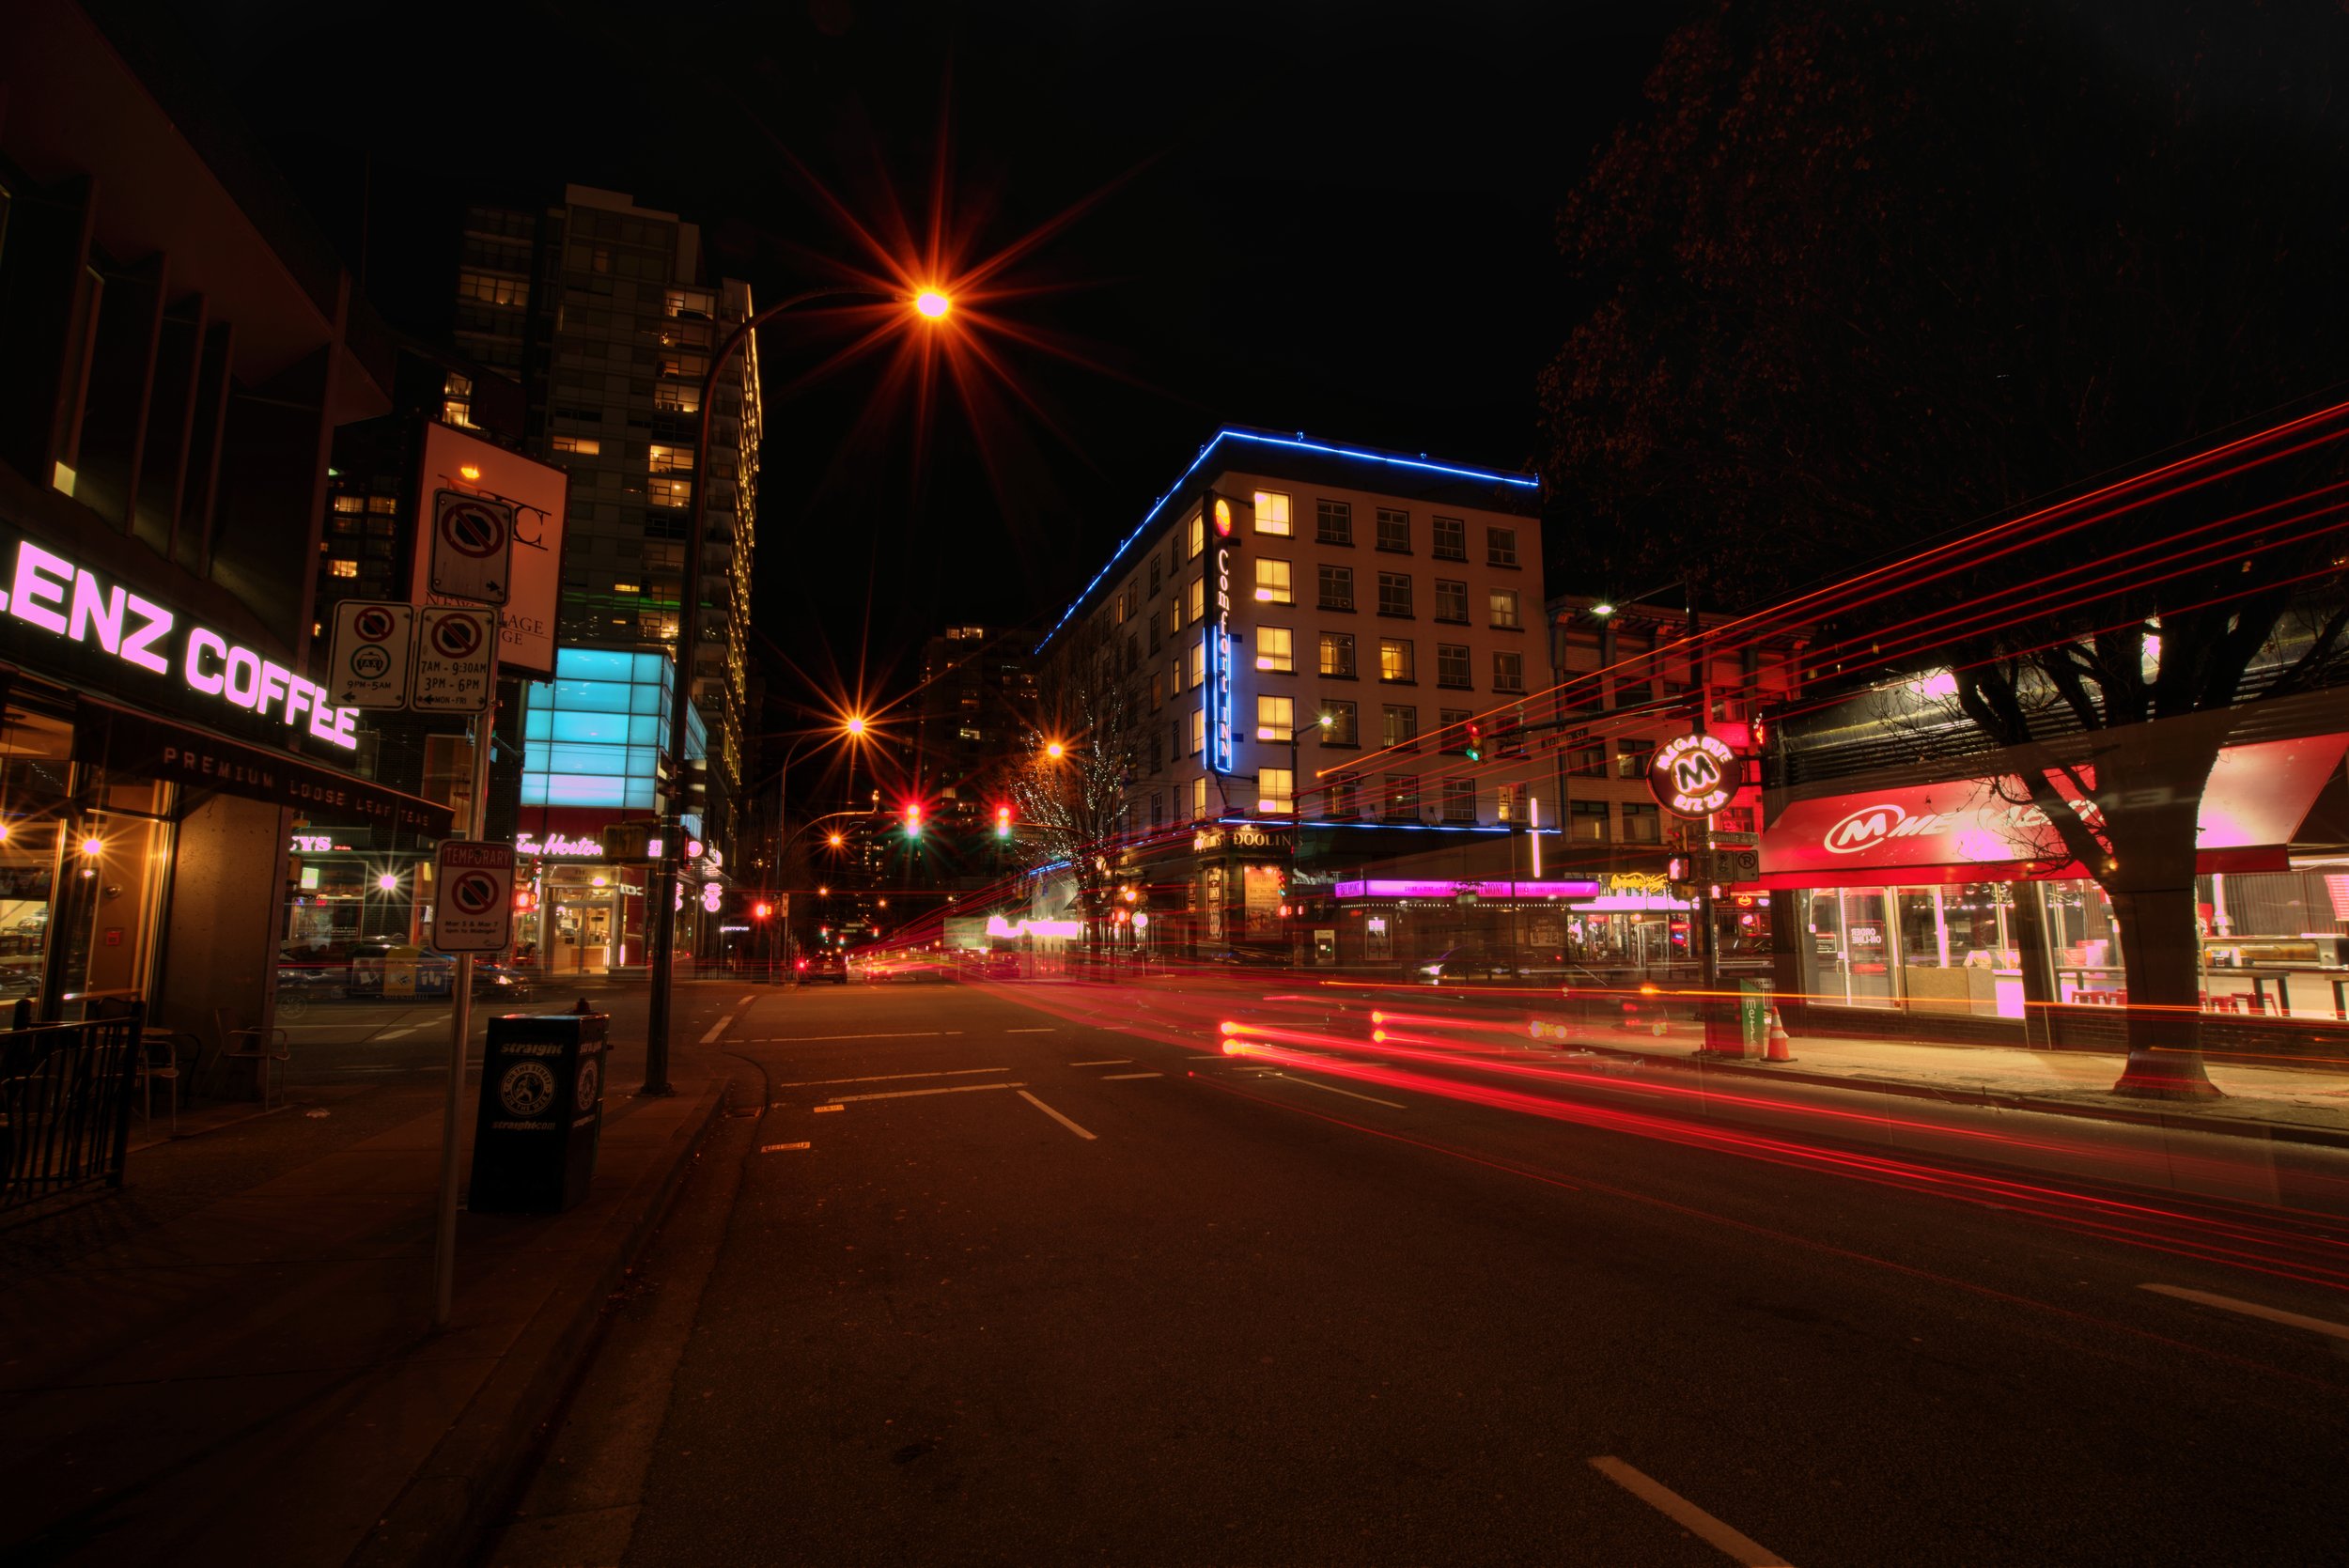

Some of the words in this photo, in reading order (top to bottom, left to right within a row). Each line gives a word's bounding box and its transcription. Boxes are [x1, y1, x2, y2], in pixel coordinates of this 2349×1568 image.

[500, 612, 544, 635] LAGE
[1218, 548, 1230, 693] Comfort
[0, 540, 174, 675] ENZ
[185, 628, 360, 750] COFFEE
[421, 661, 440, 674] 7AM
[452, 662, 487, 675] 9:30AM
[425, 677, 445, 691] 3PM
[458, 679, 479, 692] 6PM
[1220, 706, 1229, 757] INN
[1657, 736, 1700, 769] MEGA
[1701, 737, 1734, 764] BITE
[162, 746, 274, 789] PREMIUM
[288, 779, 347, 807] LOOSE
[355, 798, 391, 818] LEAF
[399, 809, 429, 827] TEAS
[1673, 790, 1728, 812] PIZZA
[543, 833, 602, 856] Horton
[1710, 832, 1739, 843] Granville
[445, 847, 511, 865] TEMPORARY
[500, 1043, 563, 1056] straight
